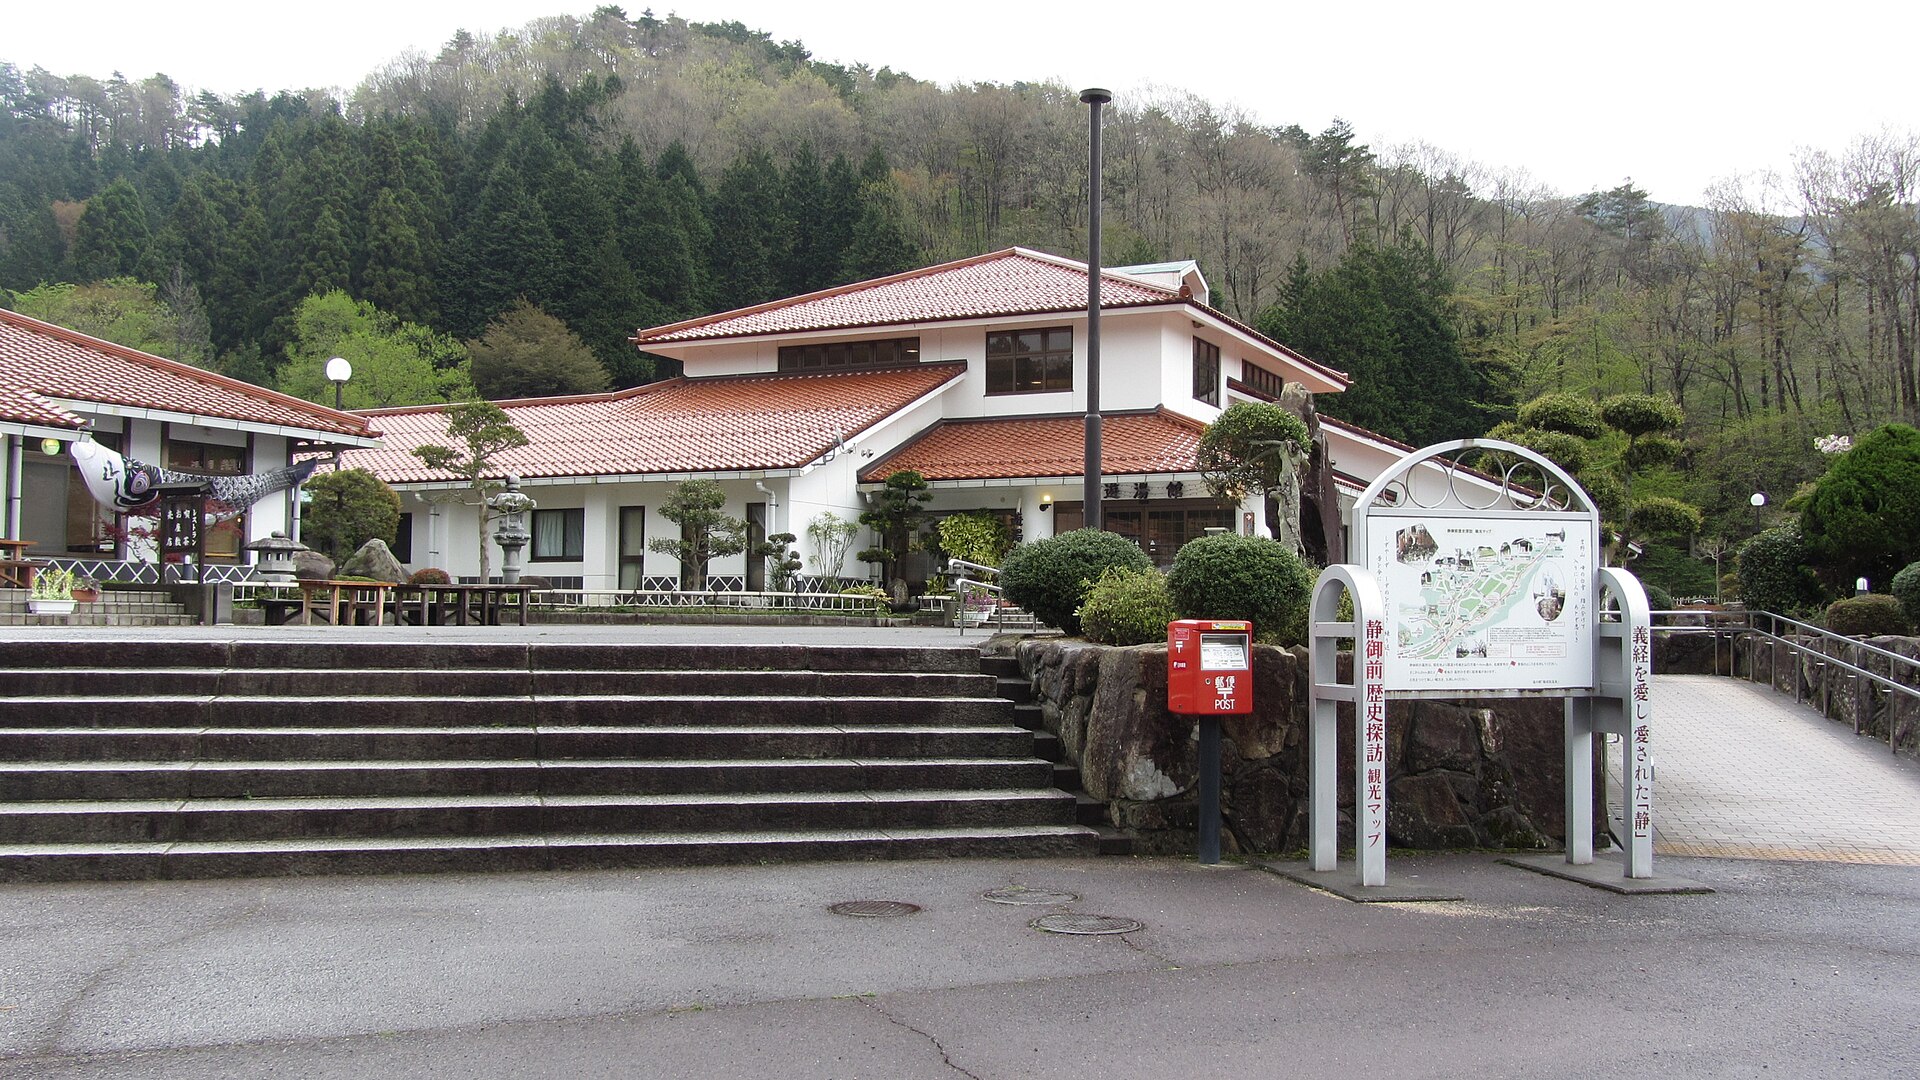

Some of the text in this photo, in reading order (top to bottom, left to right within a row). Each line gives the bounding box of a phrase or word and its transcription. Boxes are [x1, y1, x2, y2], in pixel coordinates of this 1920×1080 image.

[1214, 675, 1235, 689] 郵便
[1214, 699, 1236, 710] POST
[1366, 619, 1384, 848] 静御前 歴史探訪 観光マップ
